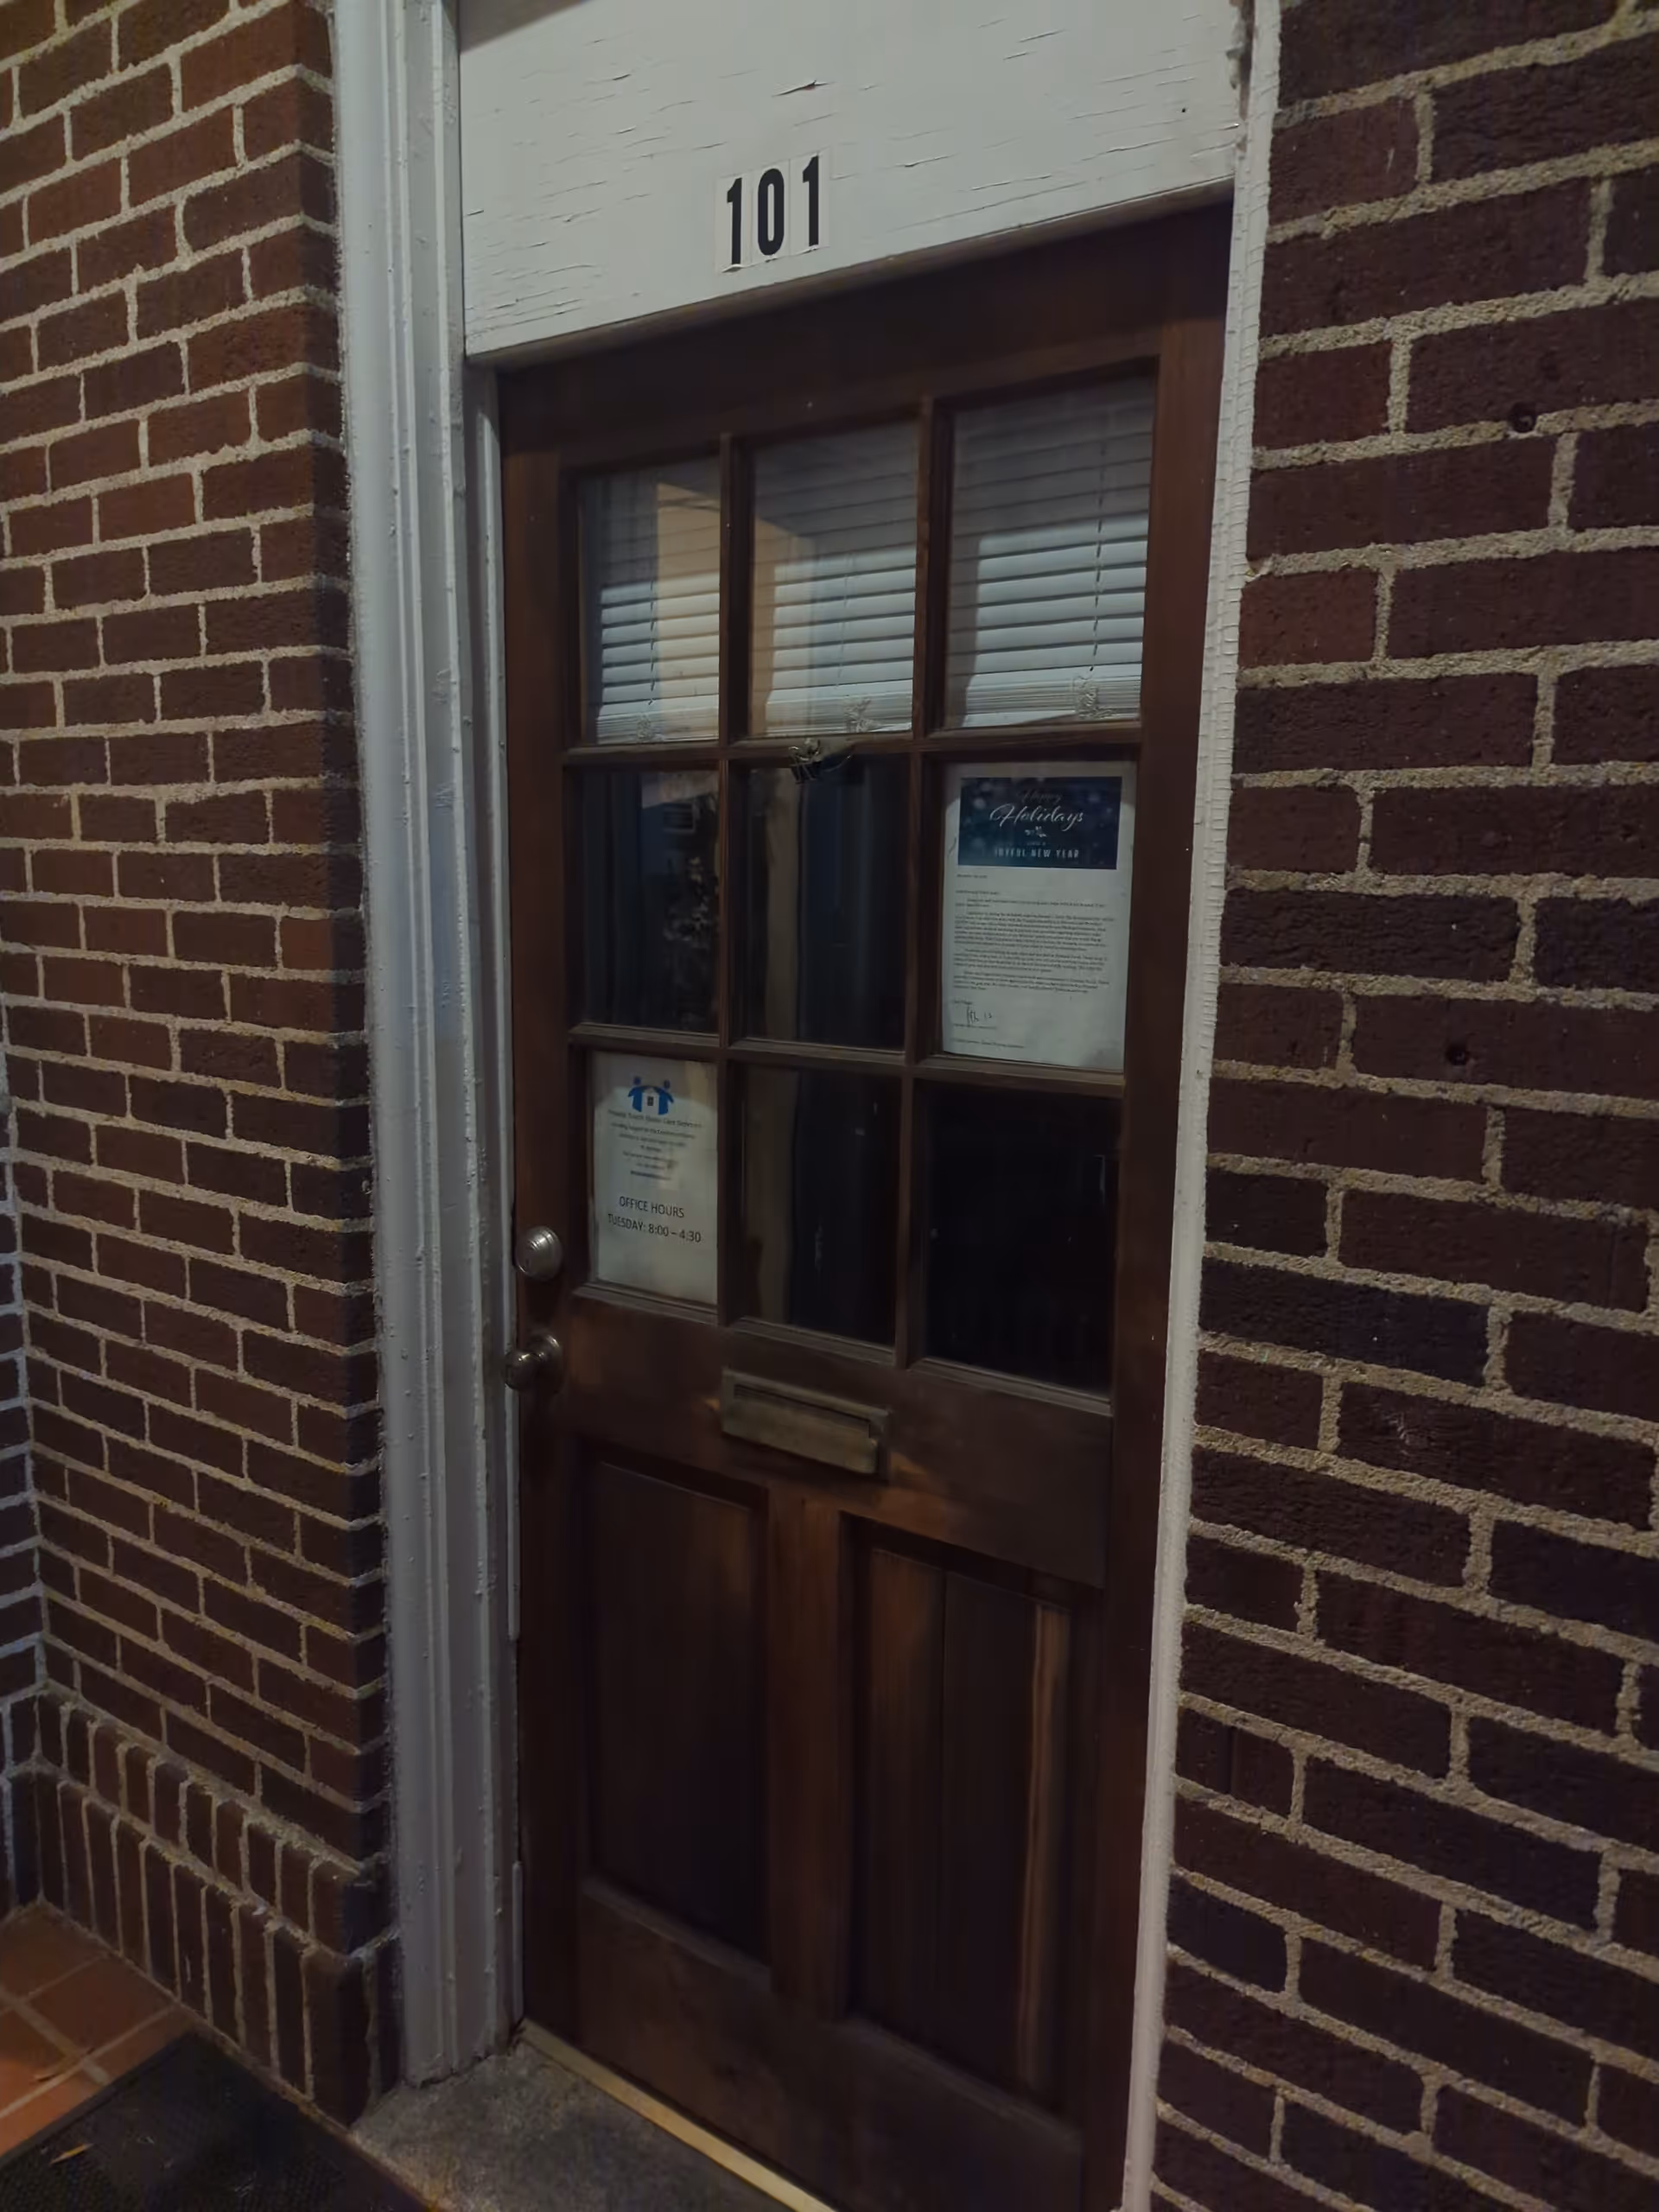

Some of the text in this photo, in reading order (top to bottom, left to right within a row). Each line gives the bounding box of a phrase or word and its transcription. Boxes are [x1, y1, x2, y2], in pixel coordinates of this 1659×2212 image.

[727, 155, 819, 265] 101
[988, 804, 1084, 832] Holidays
[1030, 848, 1052, 859] NEW
[1055, 849, 1079, 859] YEAR
[620, 1196, 684, 1218] OFFICE HOURS
[607, 1213, 646, 1232] TUESDAY:
[648, 1223, 670, 1237] 8:00
[678, 1229, 702, 1243] 4:30
